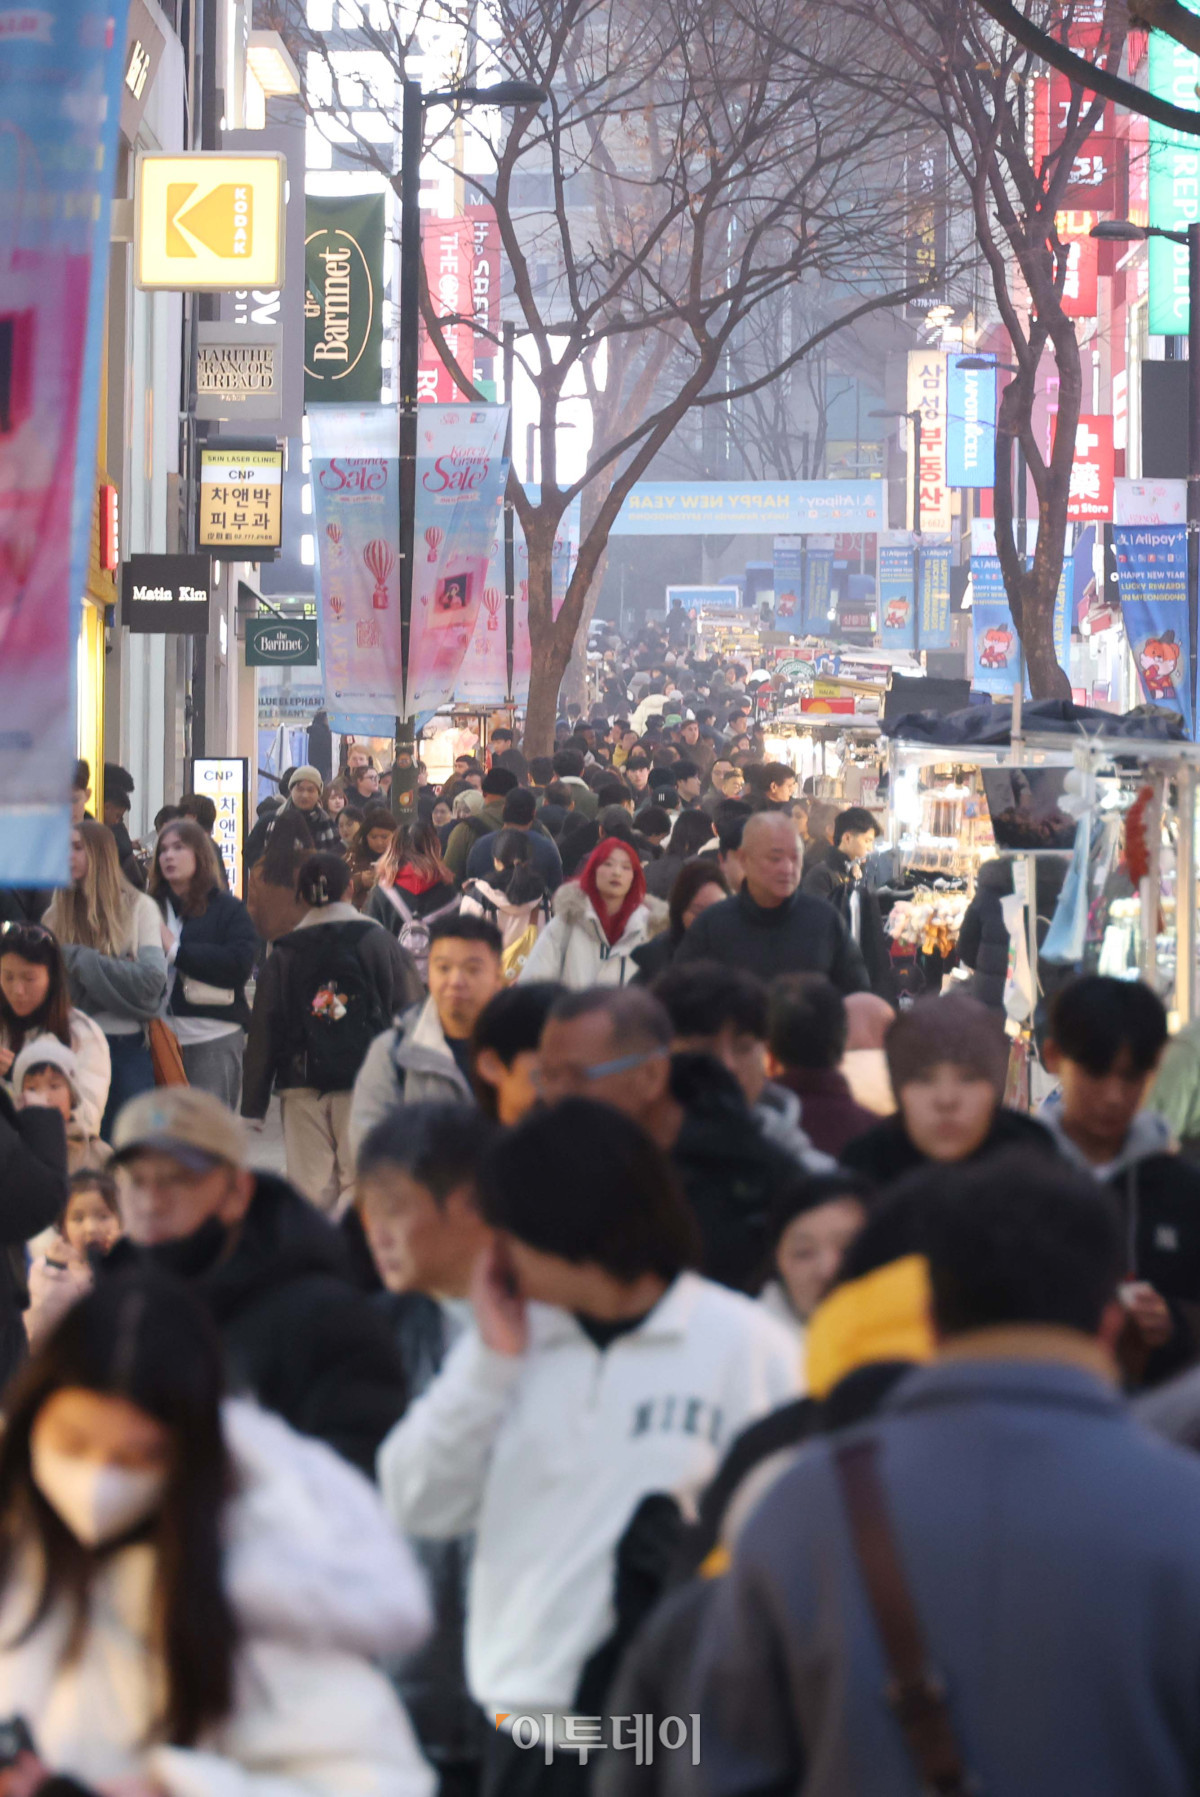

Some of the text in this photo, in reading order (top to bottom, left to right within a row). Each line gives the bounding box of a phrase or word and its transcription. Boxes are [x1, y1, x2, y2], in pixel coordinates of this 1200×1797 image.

[234, 187, 247, 255] KODAK
[313, 247, 351, 362] Barnnet
[228, 470, 255, 480] CNP
[319, 457, 389, 491] Sale
[422, 455, 489, 493] Sale
[1069, 462, 1100, 499] 藥
[211, 487, 272, 509] 차앤박
[1081, 503, 1108, 513] Store
[210, 511, 271, 530] 피부과
[1135, 532, 1184, 546] Alipay+
[1121, 571, 1185, 579] HAPPY NEW YEAR
[132, 586, 207, 601] Matin Kim
[260, 636, 302, 651] Barnnet
[276, 630, 287, 639] the
[1054, 643, 1063, 665] YEA
[203, 770, 233, 781] CNP
[219, 797, 236, 896] 차앤박피
